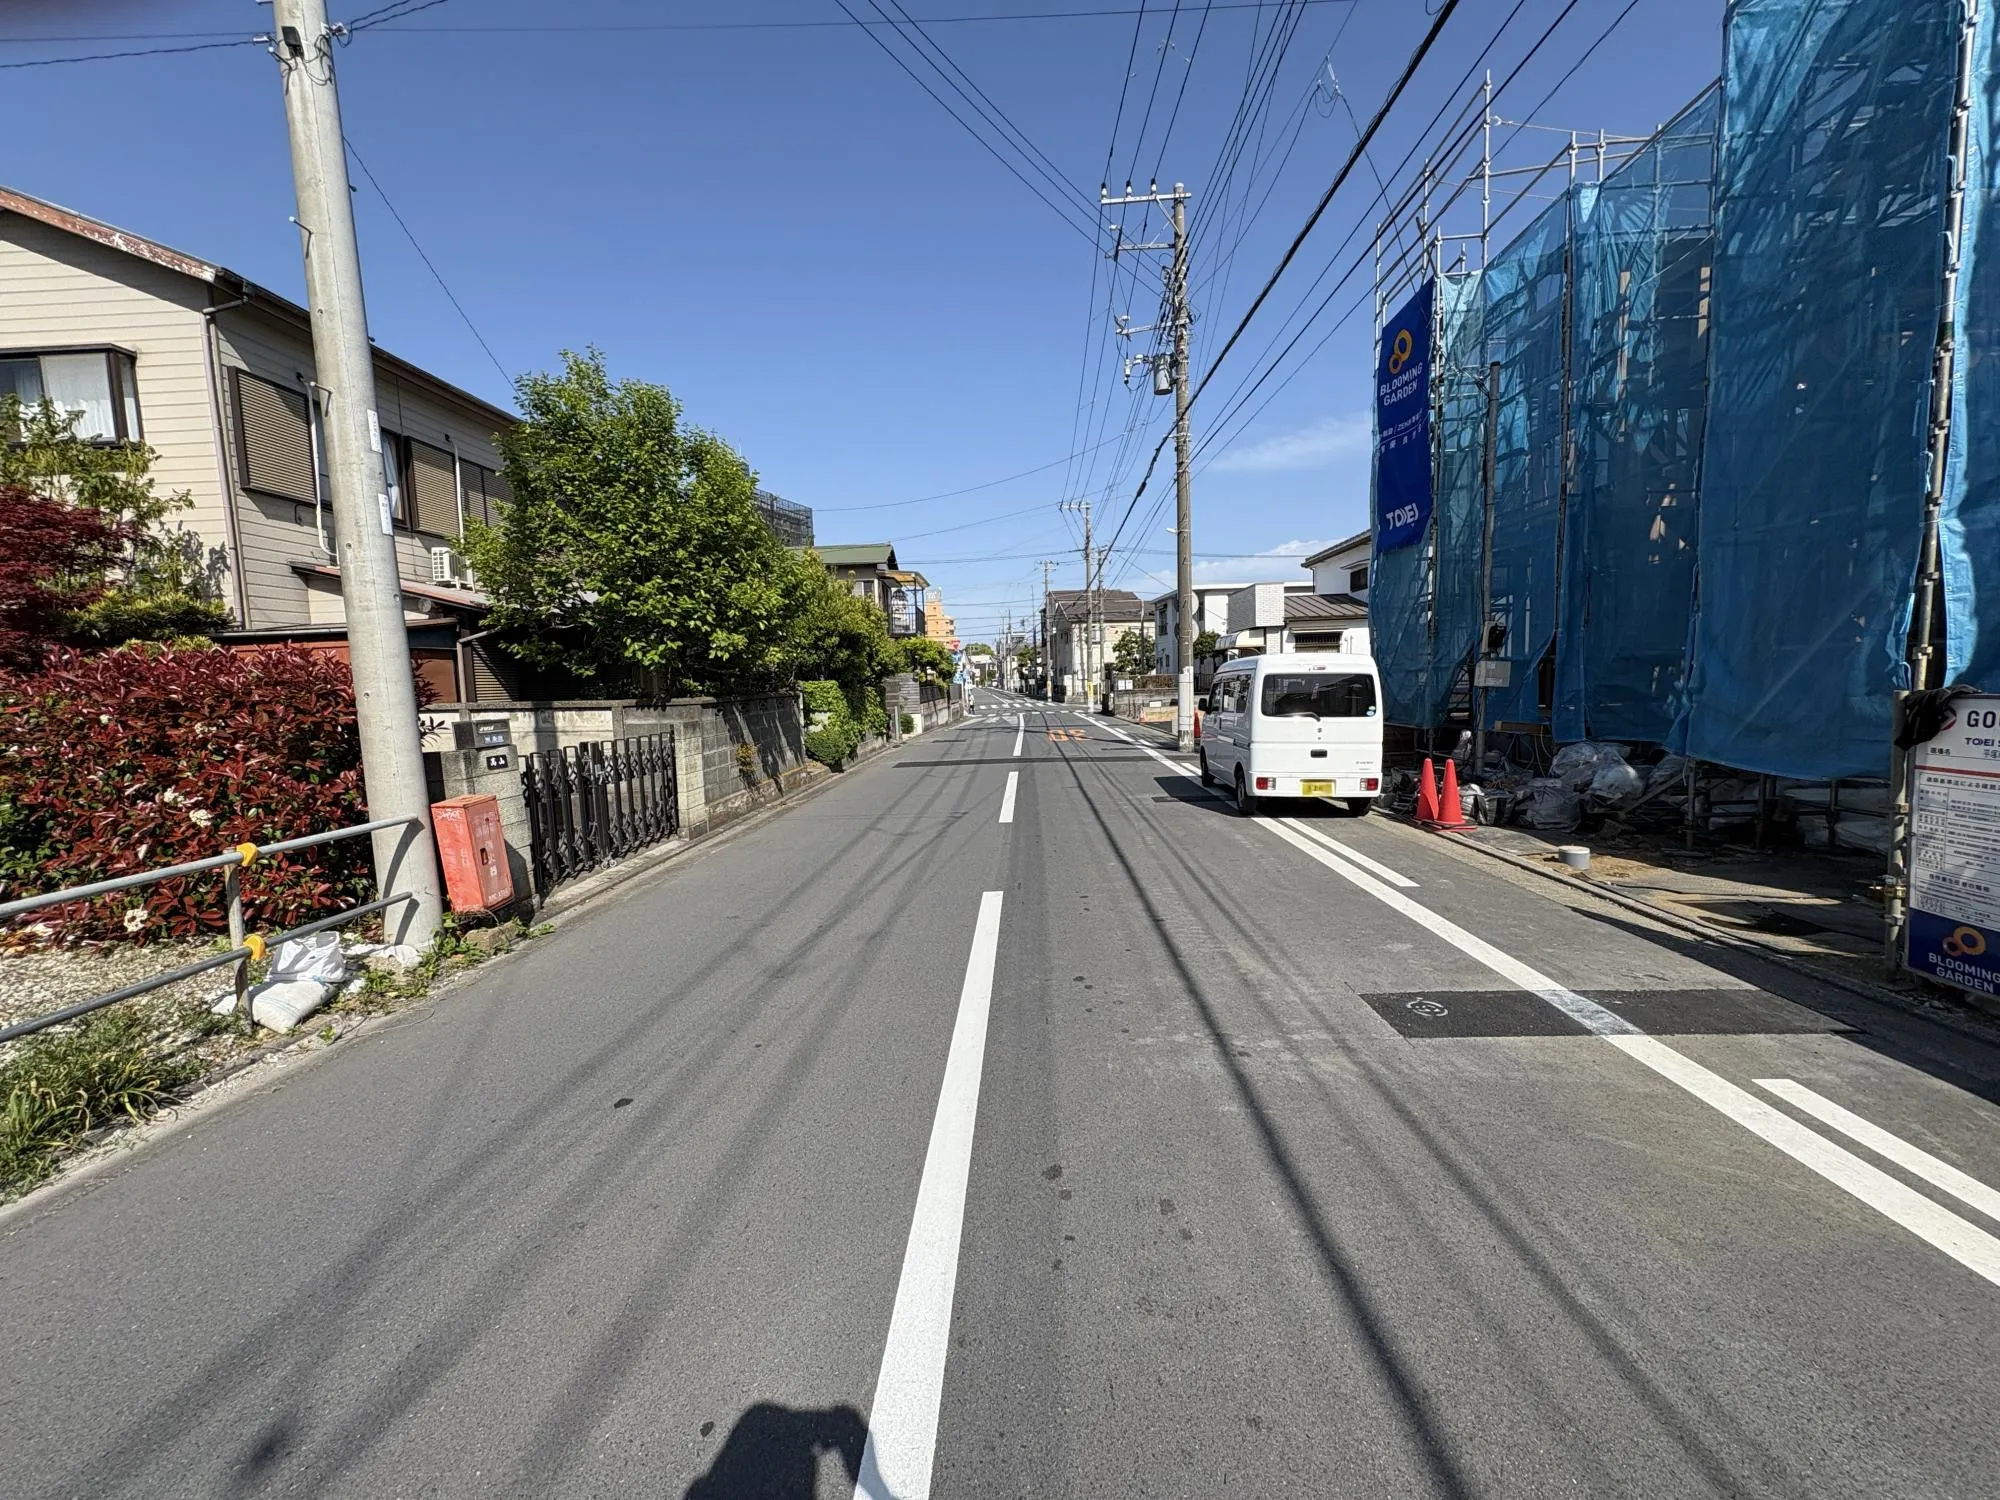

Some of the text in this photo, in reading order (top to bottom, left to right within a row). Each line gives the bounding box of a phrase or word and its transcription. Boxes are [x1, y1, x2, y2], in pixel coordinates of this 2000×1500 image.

[1380, 362, 1423, 396] BLOOMING
[1383, 379, 1418, 406] GARDEN
[1966, 709, 2000, 729] GO
[1928, 952, 2000, 983] BLOOMING
[1936, 966, 1994, 993] GARDEN
